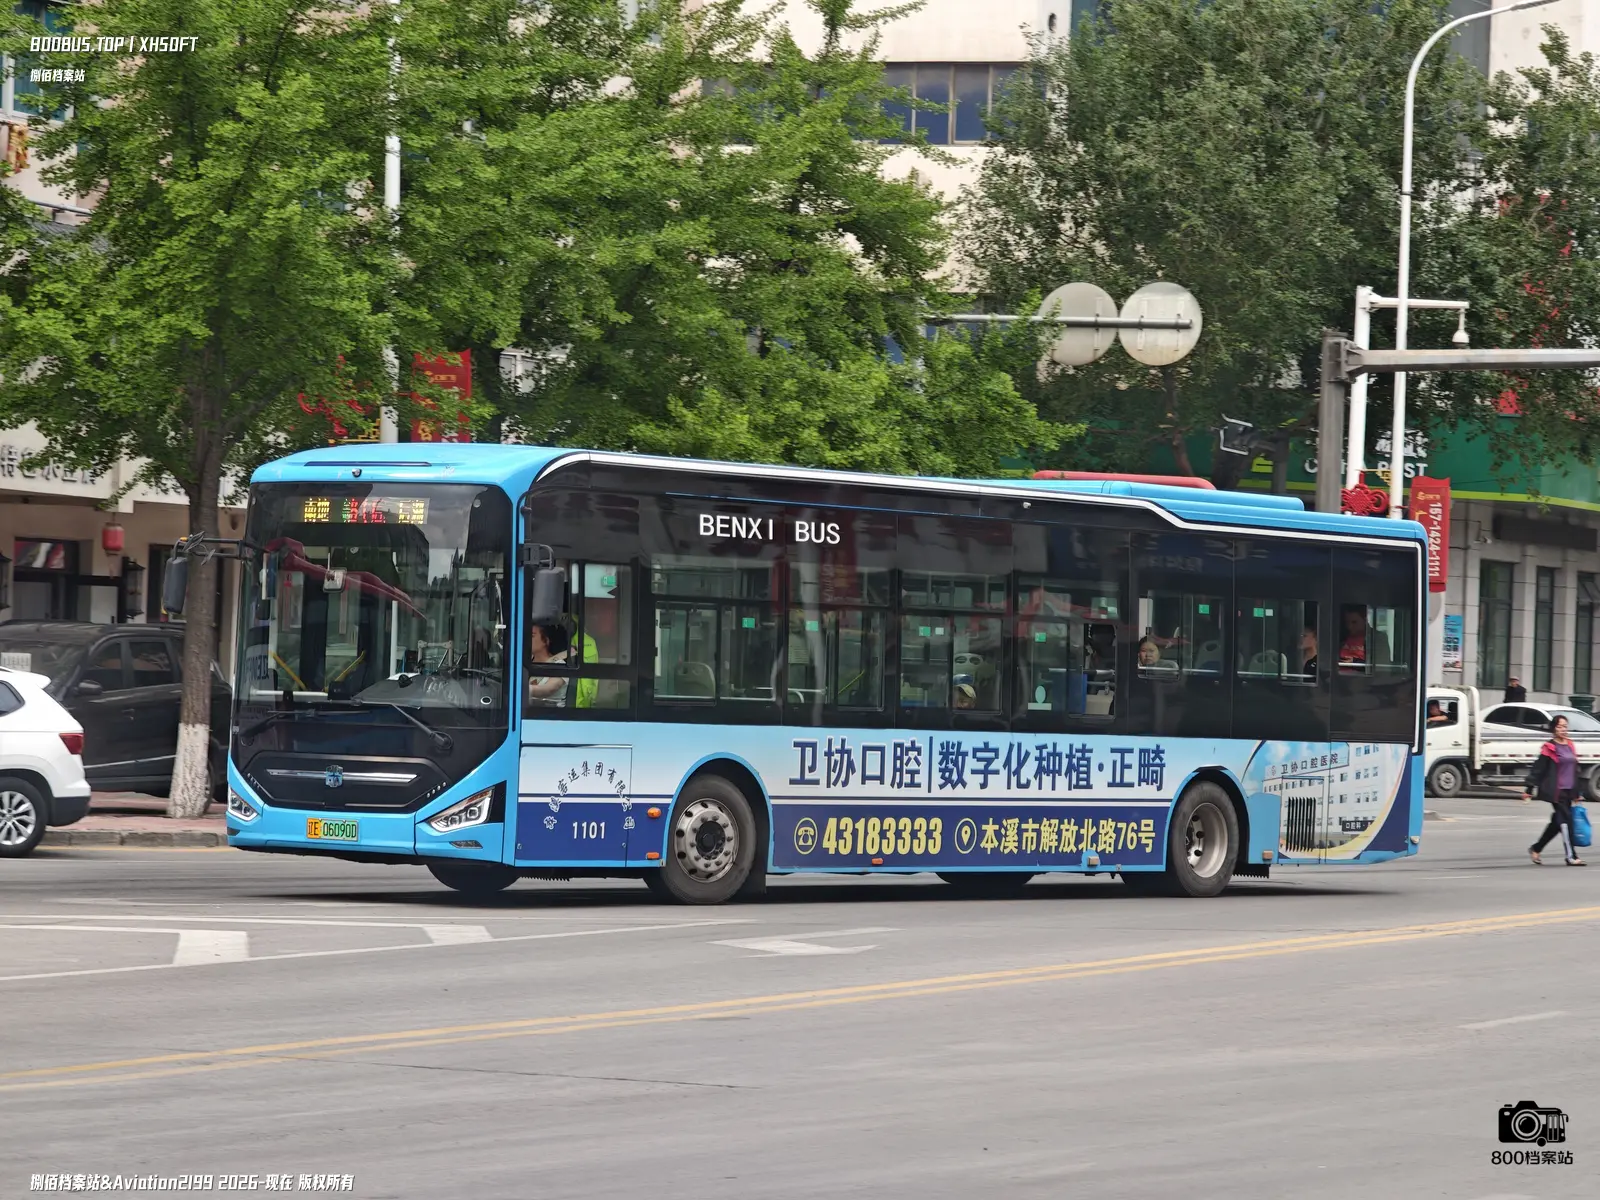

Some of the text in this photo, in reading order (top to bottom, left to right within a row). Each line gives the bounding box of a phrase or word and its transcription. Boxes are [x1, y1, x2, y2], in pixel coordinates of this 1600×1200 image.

[1377, 461, 1429, 478] PST
[699, 513, 841, 545] BENXI BUS
[1280, 752, 1339, 776] 卫协口腔医院
[572, 821, 606, 839] 1101
[822, 817, 943, 855] 43183333
[979, 817, 1156, 855] 本溪市解放北路76号
